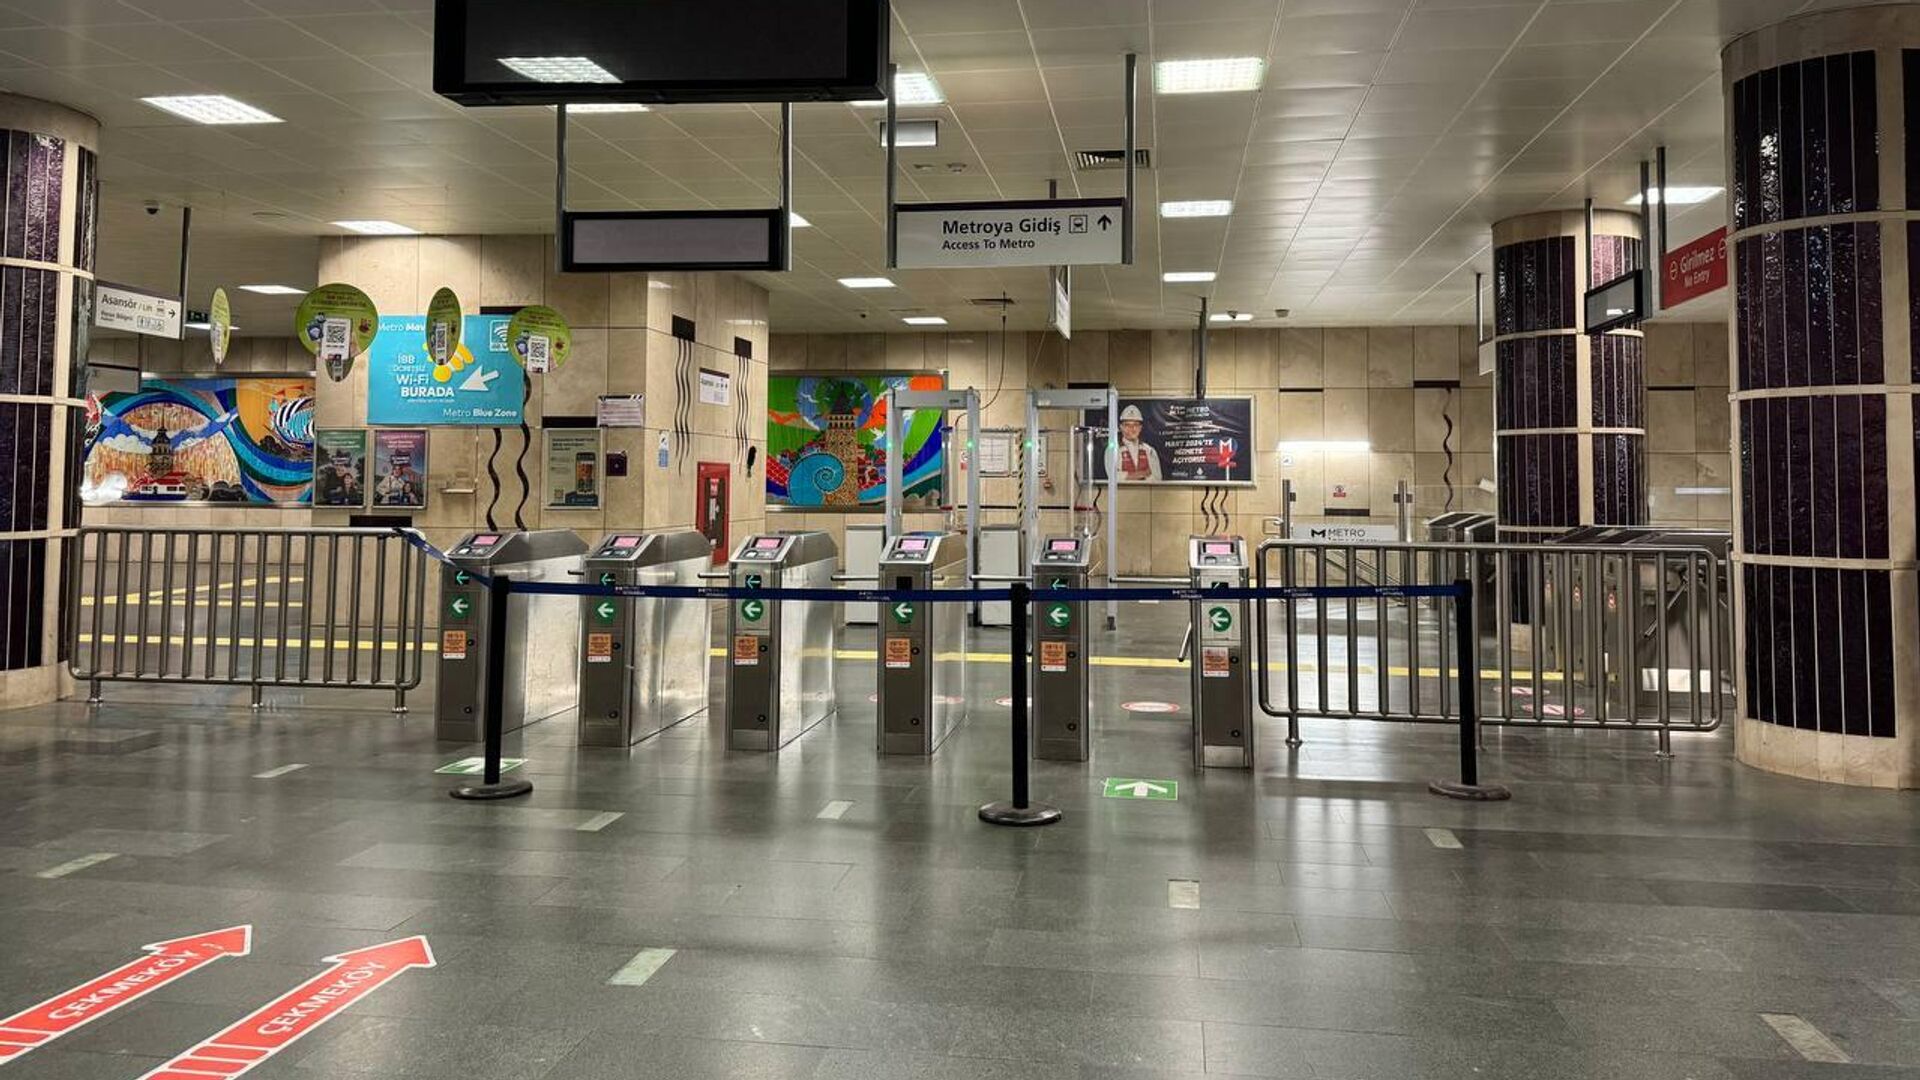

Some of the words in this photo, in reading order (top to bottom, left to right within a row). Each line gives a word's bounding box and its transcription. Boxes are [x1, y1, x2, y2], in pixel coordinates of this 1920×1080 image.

[942, 220, 1014, 237] Metroya
[1019, 217, 1061, 235] Gidiş
[942, 240, 980, 250] Access
[983, 239, 996, 249] To
[999, 239, 1036, 249] Metro
[1681, 247, 1715, 274] Girilmez
[1693, 270, 1710, 284] Entry
[101, 294, 137, 309] Asansör
[405, 322, 425, 331] Mav
[396, 373, 429, 385] Wi-Fi
[401, 386, 455, 398] BURADA
[442, 408, 471, 417] Metro
[472, 408, 493, 417] Blue
[494, 408, 517, 417] Zone
[1328, 528, 1366, 537] METRO
[47, 949, 199, 1019] ÇEKMEKÖY
[256, 961, 386, 1034] ÇEKMEKÖY
